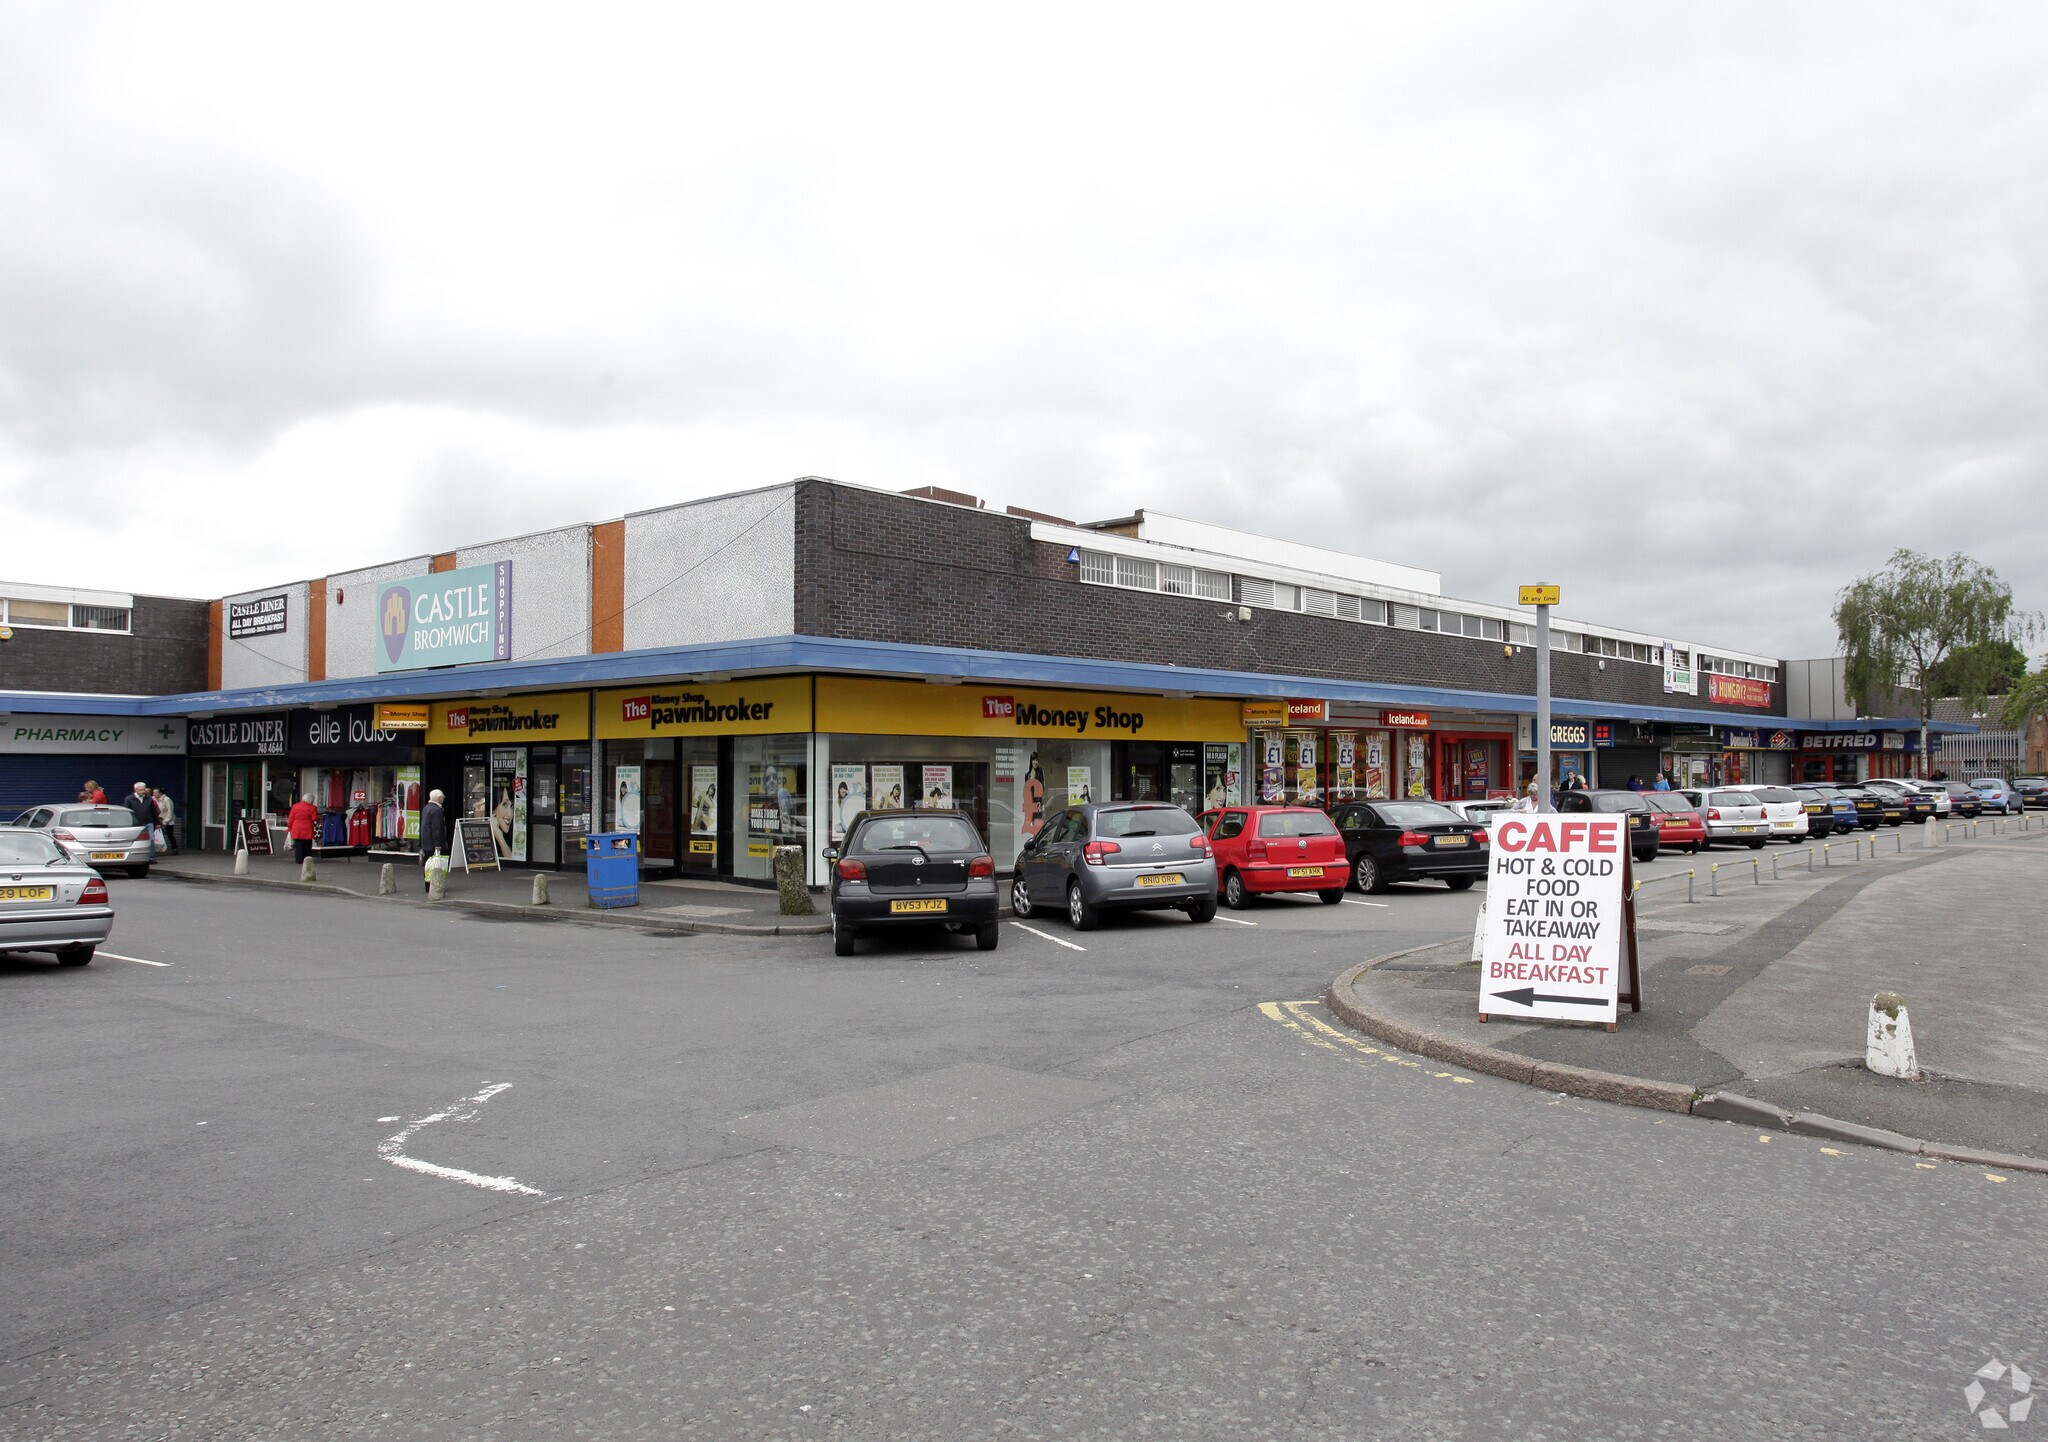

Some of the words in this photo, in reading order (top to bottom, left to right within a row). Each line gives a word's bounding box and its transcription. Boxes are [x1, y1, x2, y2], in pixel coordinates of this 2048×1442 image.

[232, 603, 260, 617] CASTLE
[260, 598, 285, 613] DINER
[414, 584, 489, 624] CASTLE
[232, 619, 242, 629] ALL
[242, 617, 253, 628] DAY
[253, 612, 285, 626] BREAKFAST
[414, 621, 489, 651] BROMWICH
[652, 695, 680, 706] Money
[682, 693, 704, 704] Shop
[469, 707, 491, 716] Money
[492, 705, 509, 714] Shop
[625, 702, 647, 718] The
[651, 698, 773, 730] pawnbroker
[987, 700, 1012, 714] The
[1016, 703, 1089, 733] Money
[1095, 707, 1144, 733] Shop
[1288, 704, 1321, 714] Iceland
[449, 713, 465, 726] The
[469, 710, 560, 737] pawnbroker
[1389, 714, 1428, 725] Iceland.co.uk
[14, 728, 124, 742] PHARMACY
[190, 722, 239, 745] CASTLE
[241, 720, 284, 743] DINER
[309, 715, 341, 745] ellie
[1550, 725, 1585, 743] GREGGS
[1802, 734, 1877, 748] BETFRED
[1883, 733, 1905, 749] BETFRED
[1268, 747, 1280, 763] £1
[1302, 748, 1313, 763] £1
[1340, 749, 1352, 763] £5
[1370, 750, 1380, 764] £1
[502, 760, 516, 769] FLASH
[1497, 821, 1618, 853] CAFE
[1497, 858, 1535, 874] HOT
[1541, 858, 1556, 876] &
[1563, 859, 1613, 876] COLD
[1143, 877, 1160, 885] BN10
[1526, 879, 1580, 896] FOOD
[20, 888, 46, 897] LOF
[896, 901, 922, 910] BV53
[923, 900, 943, 909] YJZ
[1506, 899, 1539, 916] EAT
[1545, 900, 1563, 917] IN
[1571, 901, 1598, 918] OR
[1503, 919, 1600, 939] TAKEAWAY
[1508, 943, 1544, 960] ALL
[1552, 944, 1593, 962] DAY
[1490, 962, 1609, 985] BREAKFAST
